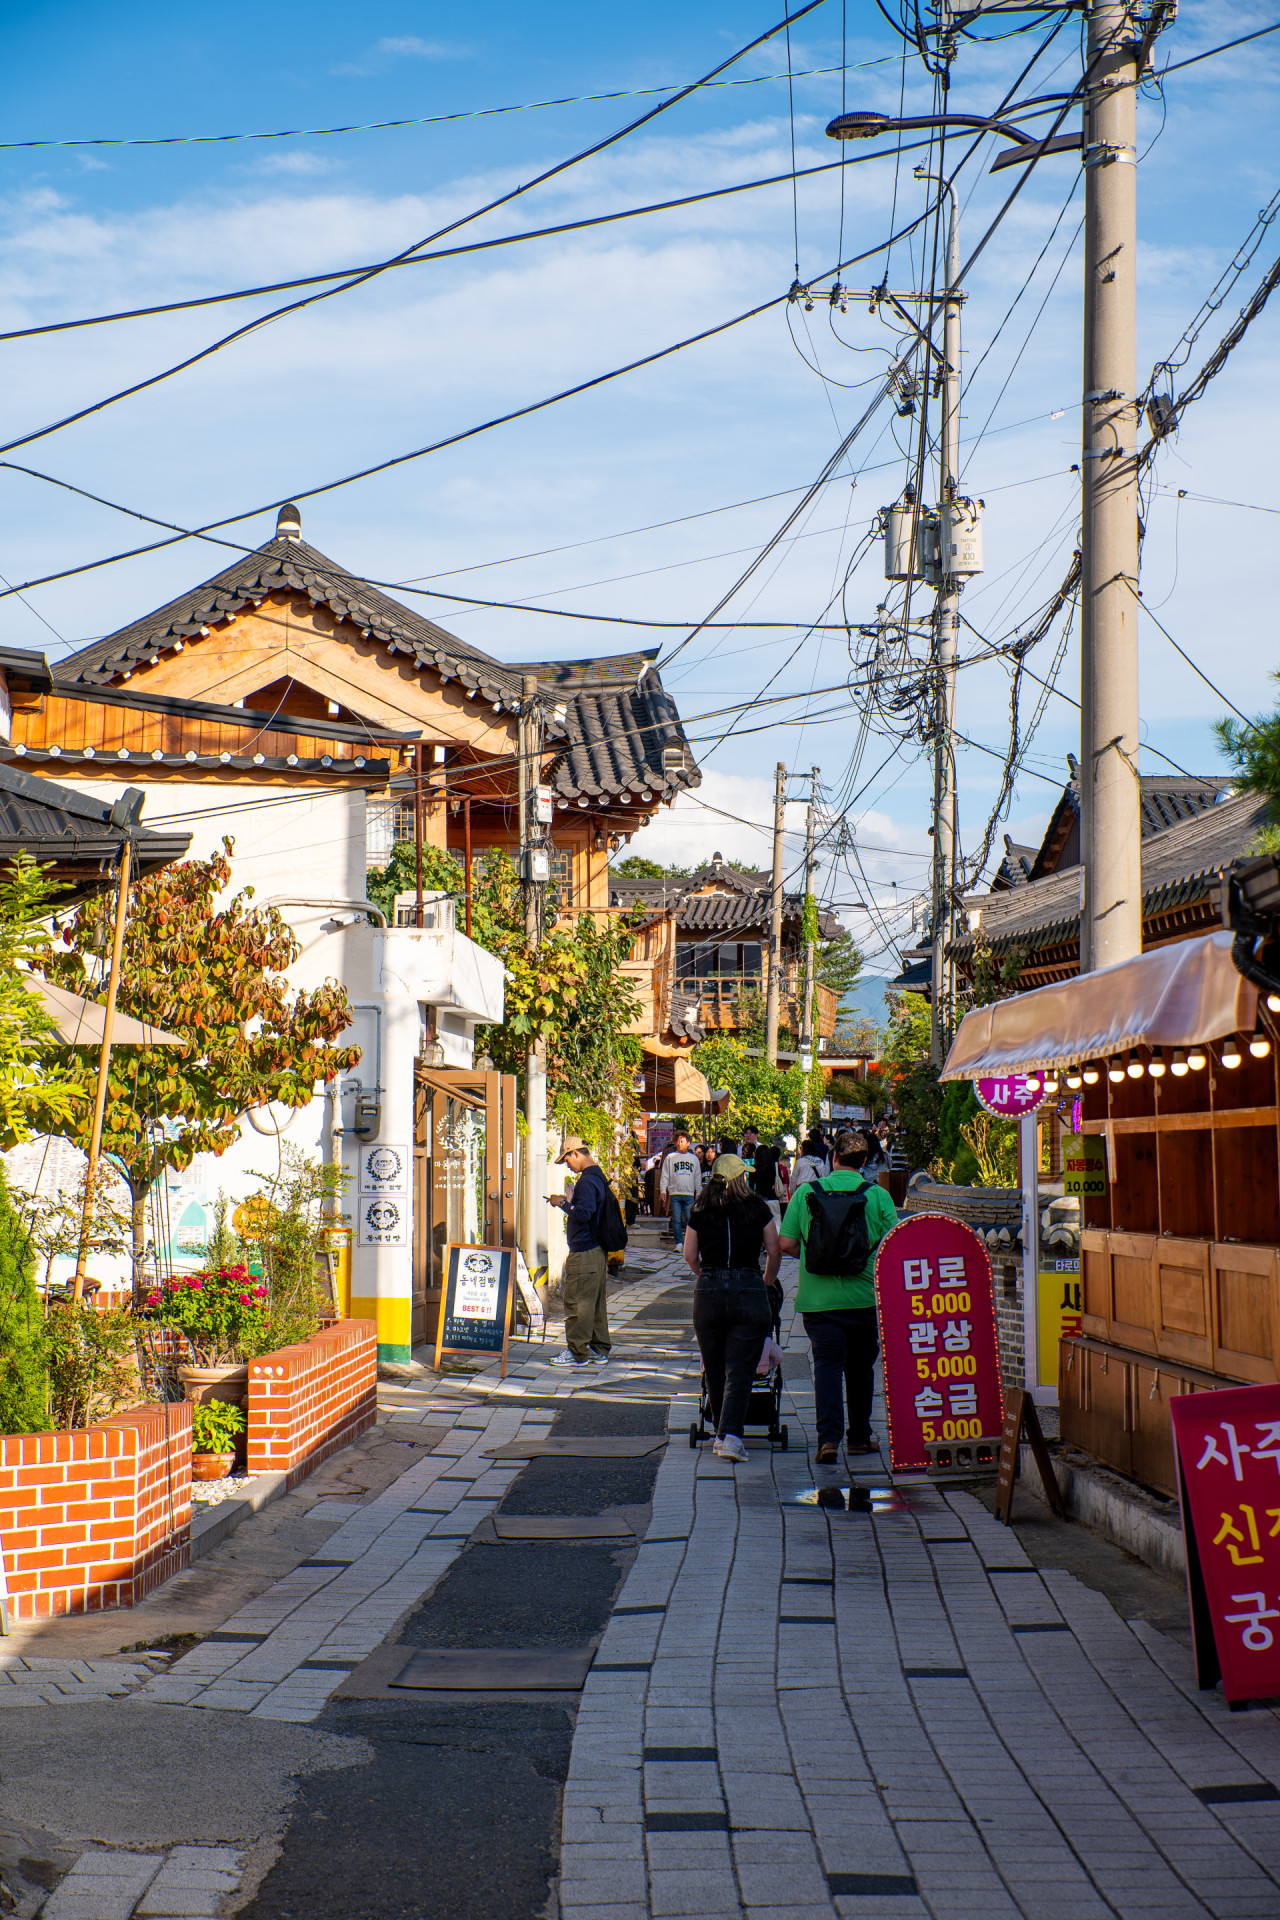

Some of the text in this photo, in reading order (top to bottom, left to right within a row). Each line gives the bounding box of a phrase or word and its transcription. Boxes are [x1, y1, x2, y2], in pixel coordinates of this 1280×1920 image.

[990, 1083, 1033, 1105] 사주
[903, 1256, 968, 1290] 타로
[462, 1305, 479, 1313] BEST
[911, 1292, 971, 1319] 5,000
[908, 1319, 973, 1354] 관상
[916, 1355, 977, 1381] 5,000
[914, 1383, 978, 1418] 손금
